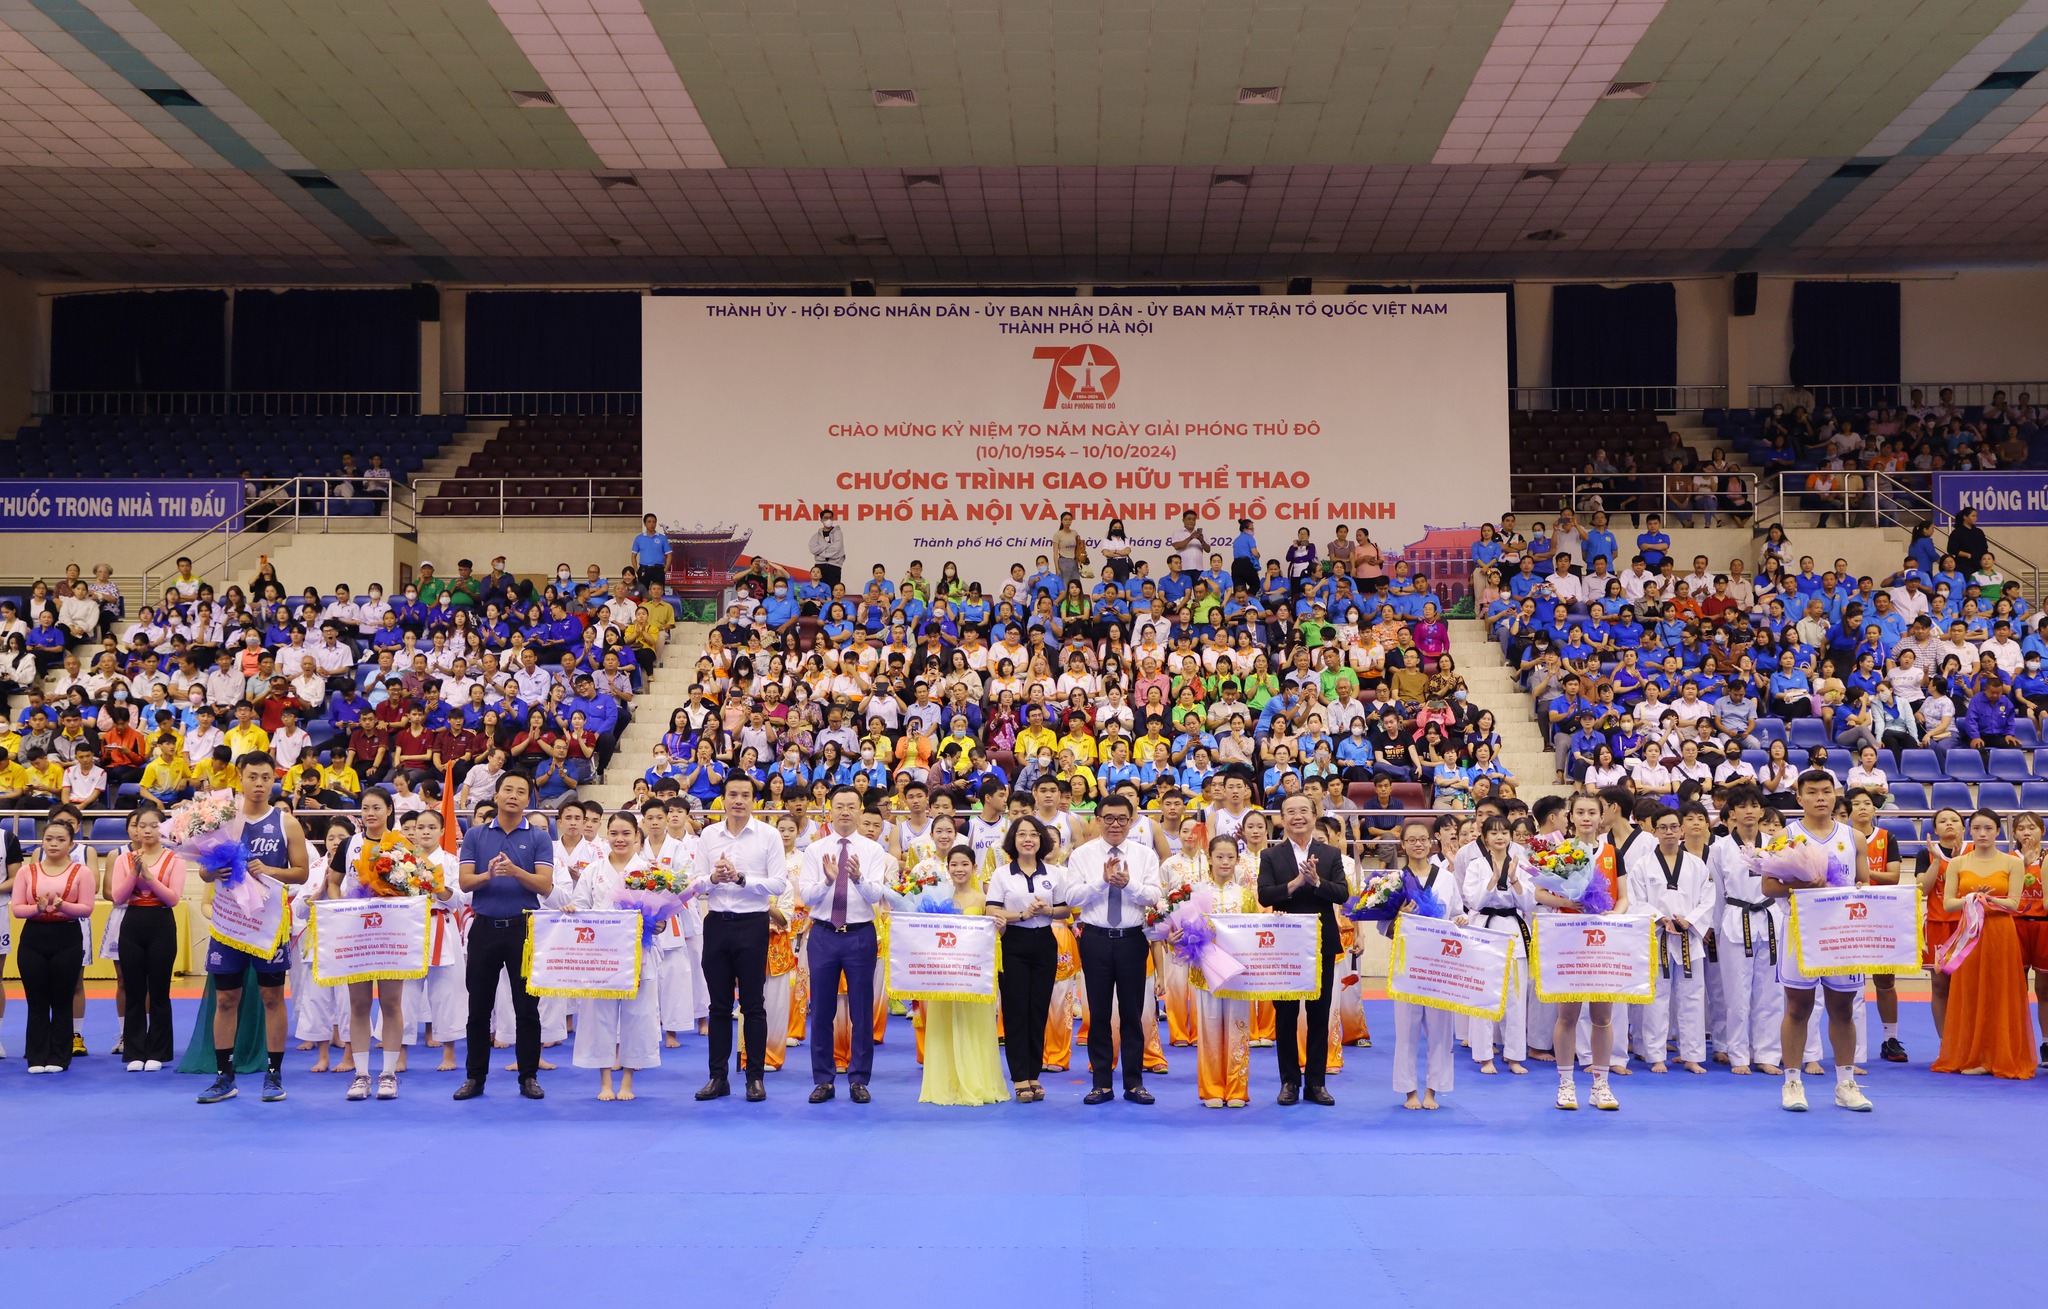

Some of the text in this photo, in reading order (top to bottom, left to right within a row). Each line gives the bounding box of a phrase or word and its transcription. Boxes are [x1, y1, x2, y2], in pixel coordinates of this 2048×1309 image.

[706, 303, 761, 316] THÀNH
[767, 302, 787, 316] ỦY
[802, 303, 828, 319] HỘI
[834, 302, 880, 317] ĐỒNG
[886, 303, 930, 317] NHÂN
[936, 303, 969, 317] DÂN
[985, 302, 1005, 317] ỦY
[1010, 304, 1042, 316] BAN
[1049, 303, 1093, 317] NHÂN
[1099, 303, 1132, 316] DÂN
[1148, 302, 1168, 316] ỦY
[1173, 304, 1205, 316] BAN
[1211, 302, 1245, 318] MẶT
[1249, 302, 1290, 318] TRẬN
[1295, 302, 1316, 315] TỔ
[1321, 302, 1367, 317] QUỐC
[1372, 302, 1407, 317] VIỆT
[1412, 304, 1447, 314] NAM
[999, 319, 1152, 336] THÀNH PHỐ HÀ NỘI
[1032, 344, 1120, 409] 70
[829, 422, 878, 436] CHÀO
[884, 422, 936, 436] MỪNG
[943, 420, 964, 436] KỶ
[970, 422, 1012, 439] NIỆM
[1047, 421, 1085, 436] NĂM
[1092, 421, 1140, 436] NGÀY
[1145, 420, 1179, 436] GIẢI
[1186, 421, 1247, 435] PHÓNG
[1253, 420, 1288, 435] THỦ
[1293, 420, 1320, 435] ĐÔ
[977, 444, 1066, 461] (10/10/1954
[1083, 444, 1176, 460] 10/10/2024)
[837, 466, 1310, 490] CHƯƠNG TRÌNH GIAO HỮU THỂ THAO
[56, 498, 112, 516] TRONG
[119, 492, 152, 516] NHÀ
[159, 498, 185, 516] THI
[191, 490, 225, 517] ĐẤU
[1960, 487, 2021, 510] KHÔNG
[758, 496, 1396, 526] THÀNH PHỐ HÀ NỘI VÀ THÀNH PHỐ HỒ CHÍ MINH
[913, 537, 954, 548] Thành
[956, 536, 982, 549] phố
[985, 536, 1003, 547] Hồ
[1006, 537, 1028, 548] Chí
[1030, 536, 1053, 547] Min
[1129, 536, 1161, 549] háng
[1210, 537, 1232, 547] 202
[1845, 902, 1867, 920] 70
[360, 912, 383, 929] 70
[574, 927, 595, 943] 70
[935, 931, 957, 948] 70
[1255, 931, 1275, 948] 70
[1583, 929, 1606, 946] 70
[1441, 938, 1462, 956] 70
